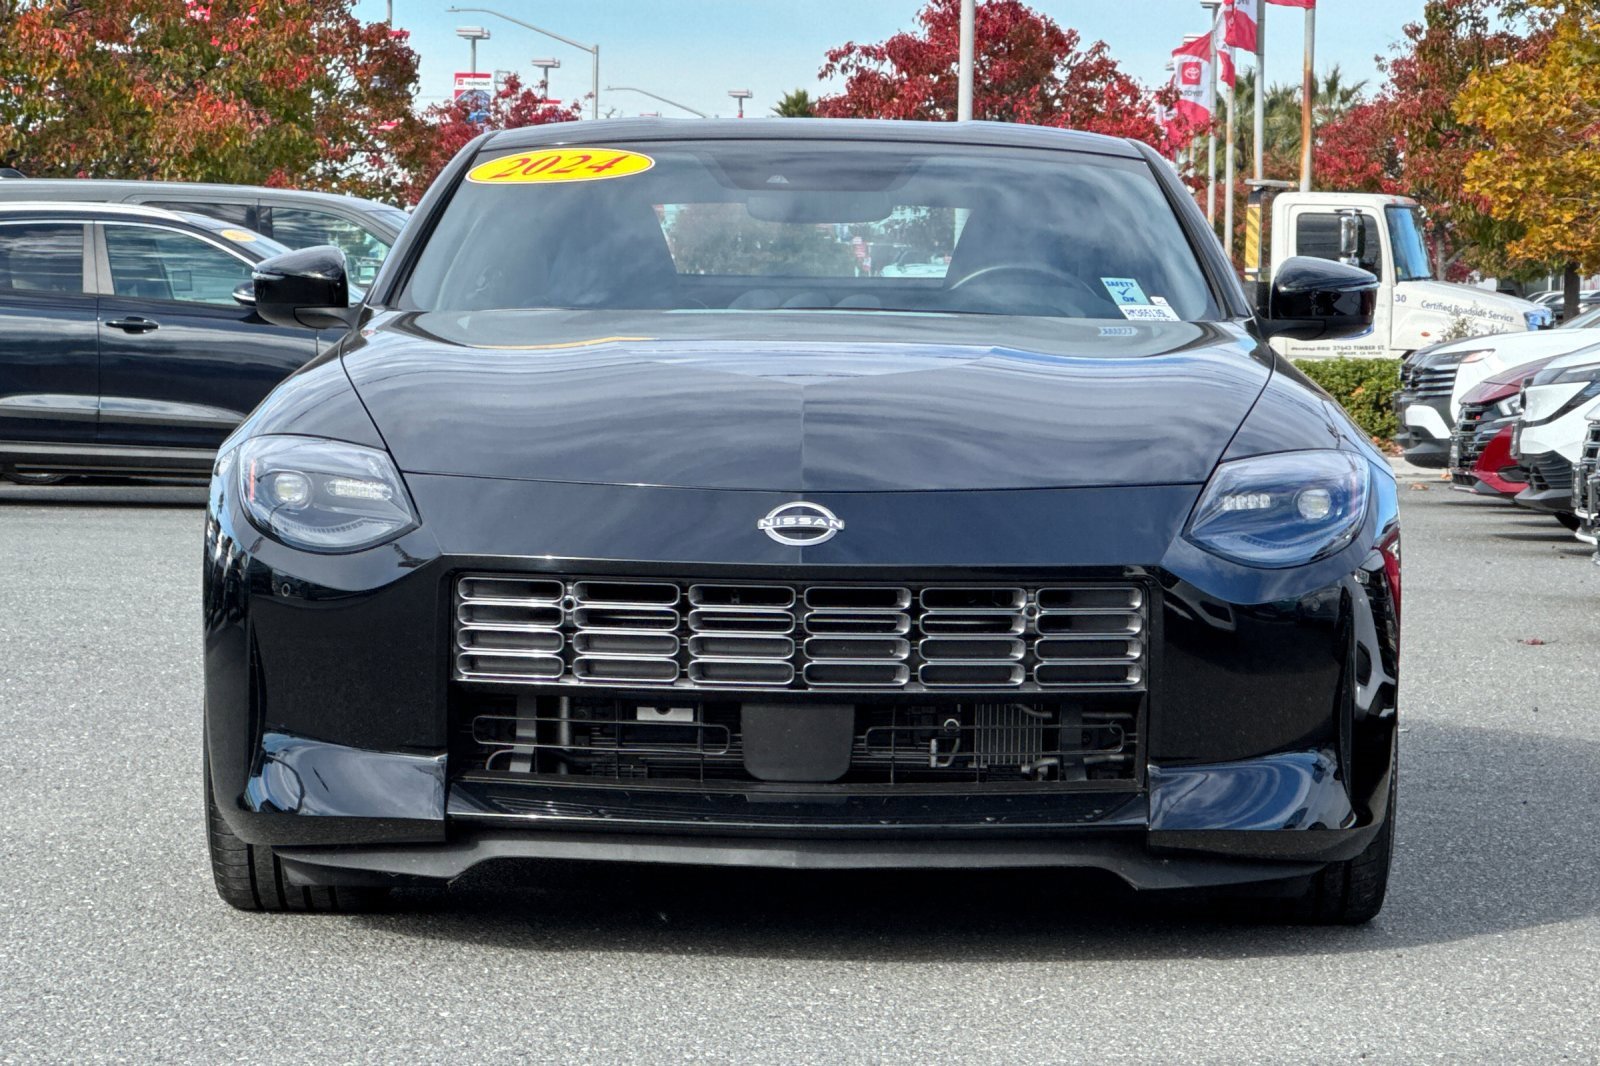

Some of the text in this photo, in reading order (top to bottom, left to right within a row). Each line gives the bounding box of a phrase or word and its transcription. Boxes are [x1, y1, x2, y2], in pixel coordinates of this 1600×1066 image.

[488, 154, 629, 179] 2024
[1395, 294, 1406, 302] 30
[1420, 299, 1515, 322] Certified Roadside Service
[1354, 340, 1375, 350] TIMBER
[760, 517, 842, 528] NISSAN
